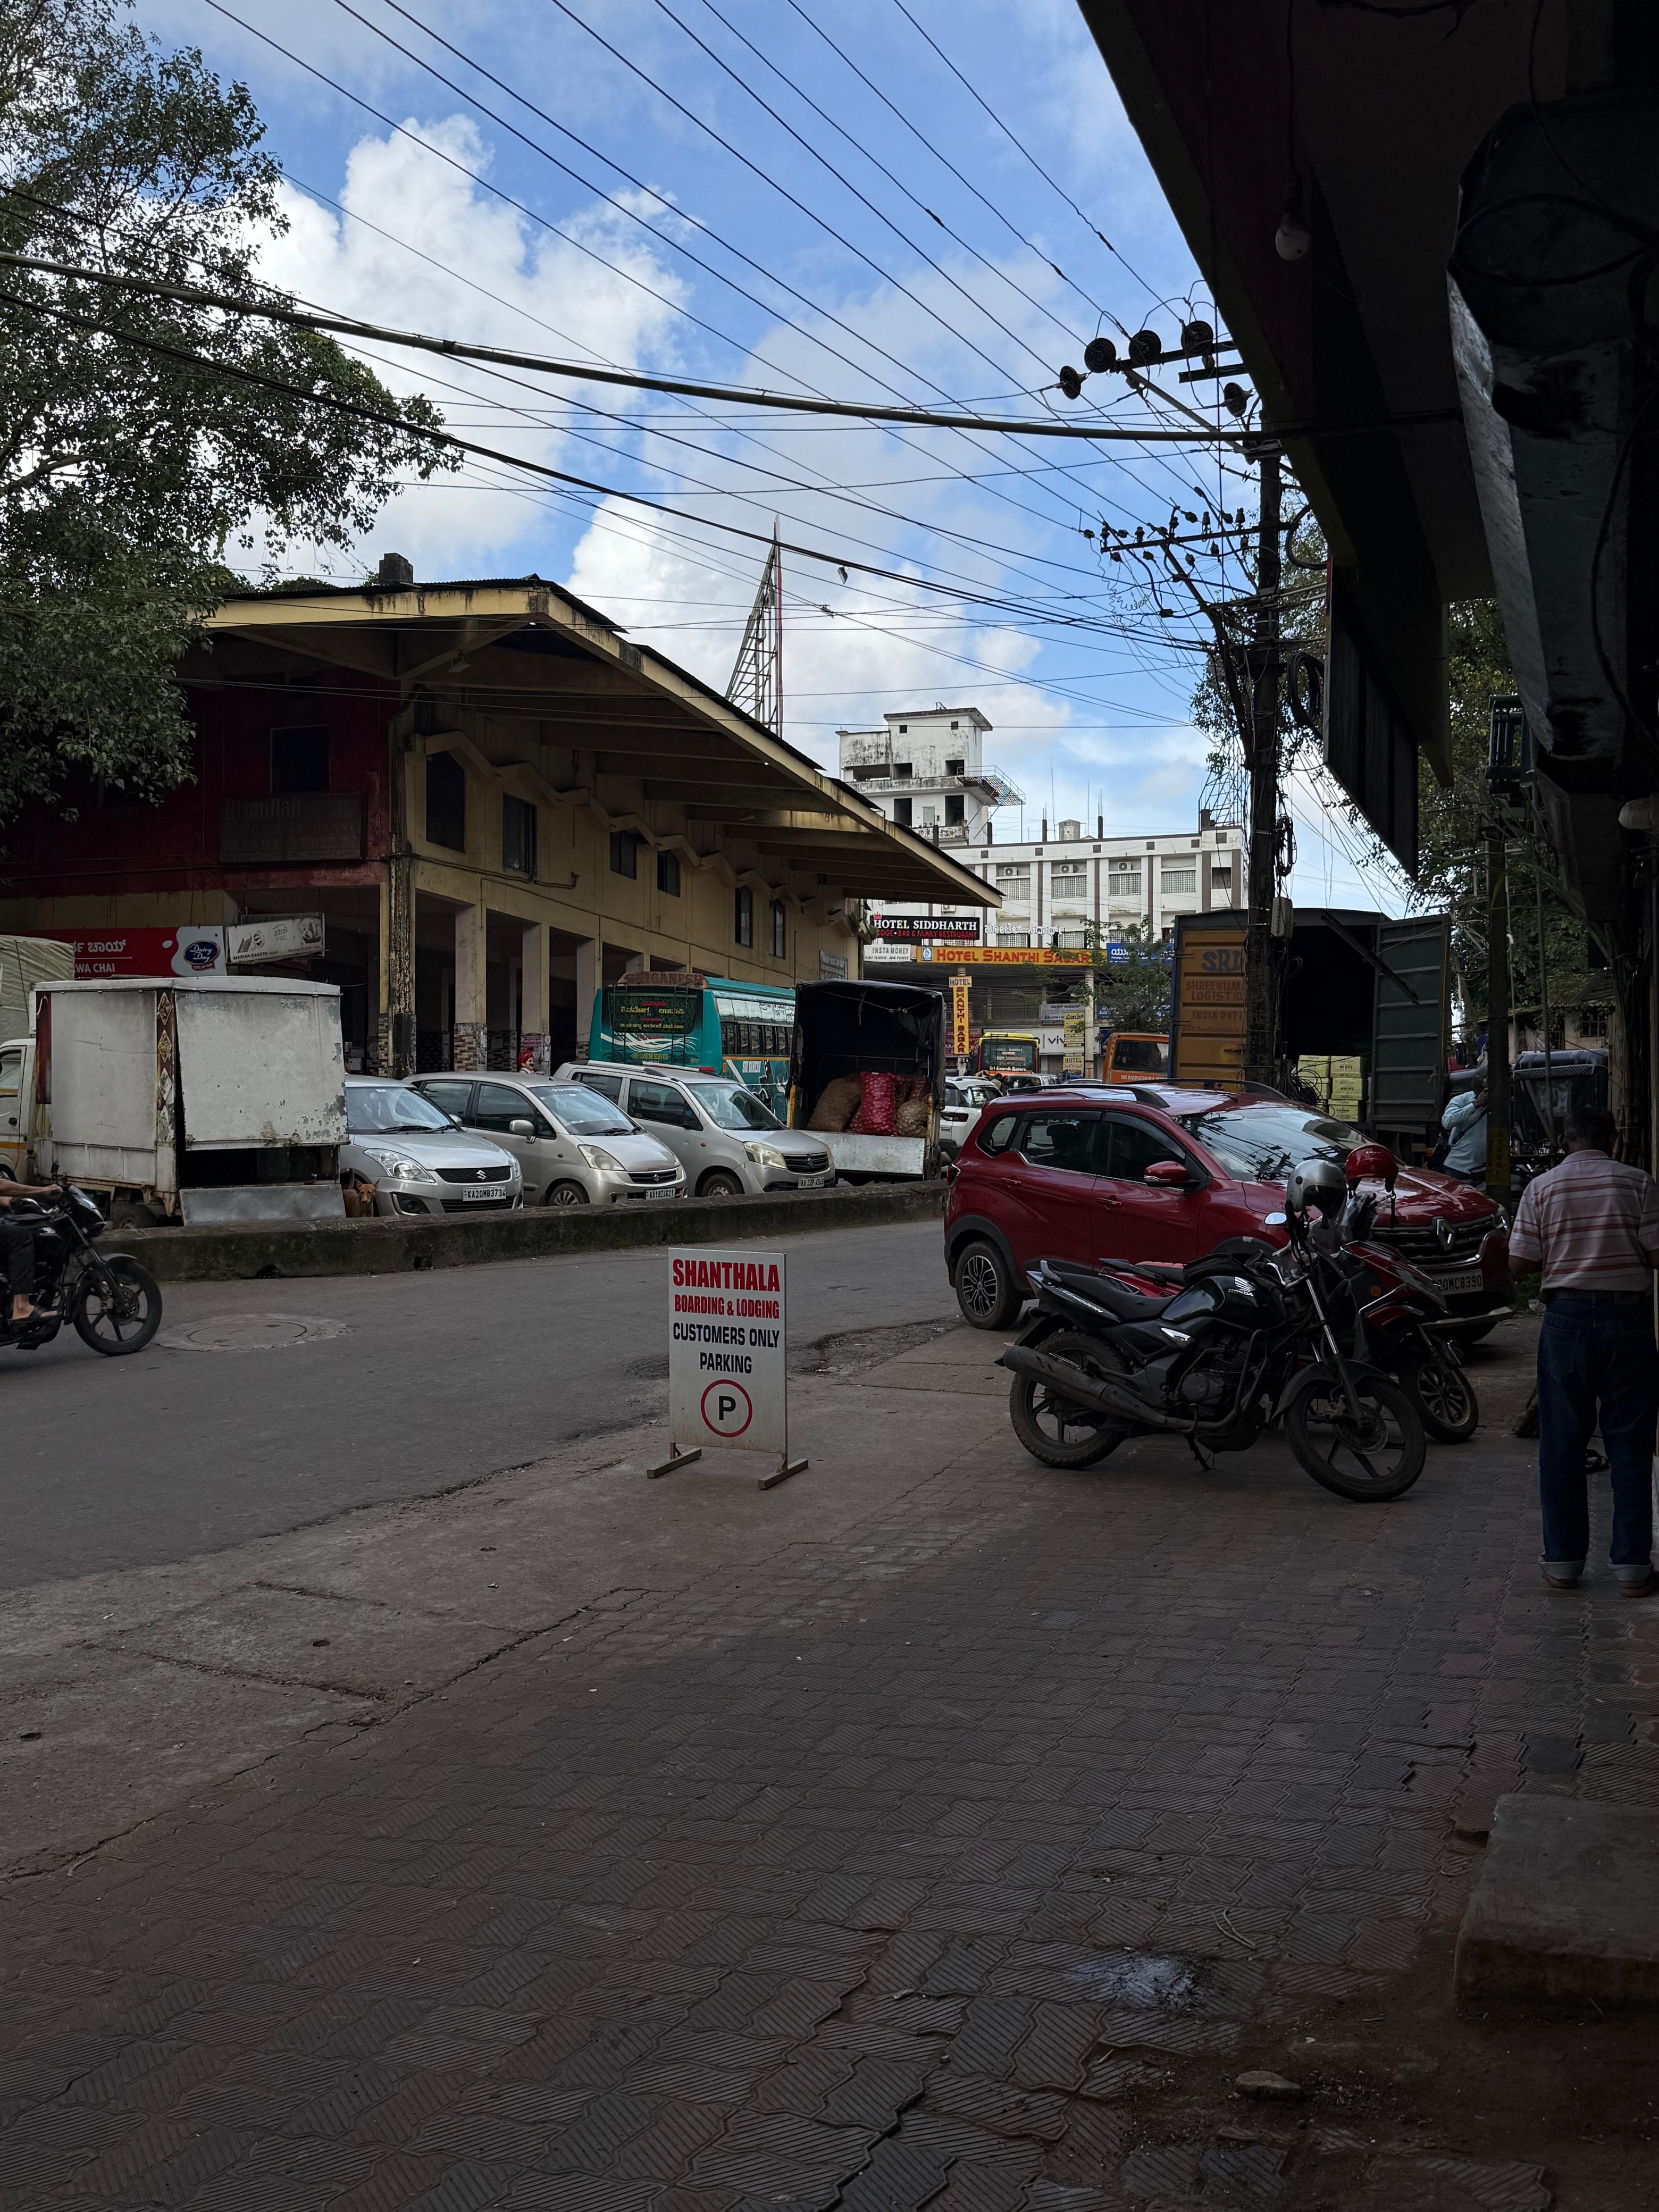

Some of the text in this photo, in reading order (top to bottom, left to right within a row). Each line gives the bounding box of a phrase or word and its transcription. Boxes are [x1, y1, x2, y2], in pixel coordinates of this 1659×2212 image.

[874, 919, 977, 931] HOTEL SIDDHARTH
[189, 944, 213, 956] Dairy
[936, 949, 978, 961] HOTEL
[983, 950, 1039, 962] SHANTHI
[193, 952, 211, 963] Day
[93, 963, 115, 973] CHAI
[1185, 981, 1244, 991] SHREEKUM
[1192, 991, 1245, 1002] LOGISTIC
[956, 987, 965, 1023] SHANTHI
[1192, 1011, 1218, 1020] INDIA
[1220, 1011, 1238, 1020] PVT
[1048, 1035, 1064, 1044] viv
[468, 1189, 506, 1199] KA20MB3734
[673, 1259, 780, 1292] SHANTHALA
[1227, 1289, 1254, 1297] HONDA
[674, 1294, 780, 1319] BOARDING & LODGING
[673, 1322, 780, 1348] CUSTOMERS ONLY
[700, 1352, 752, 1374] PARKING
[718, 1395, 736, 1420] P
